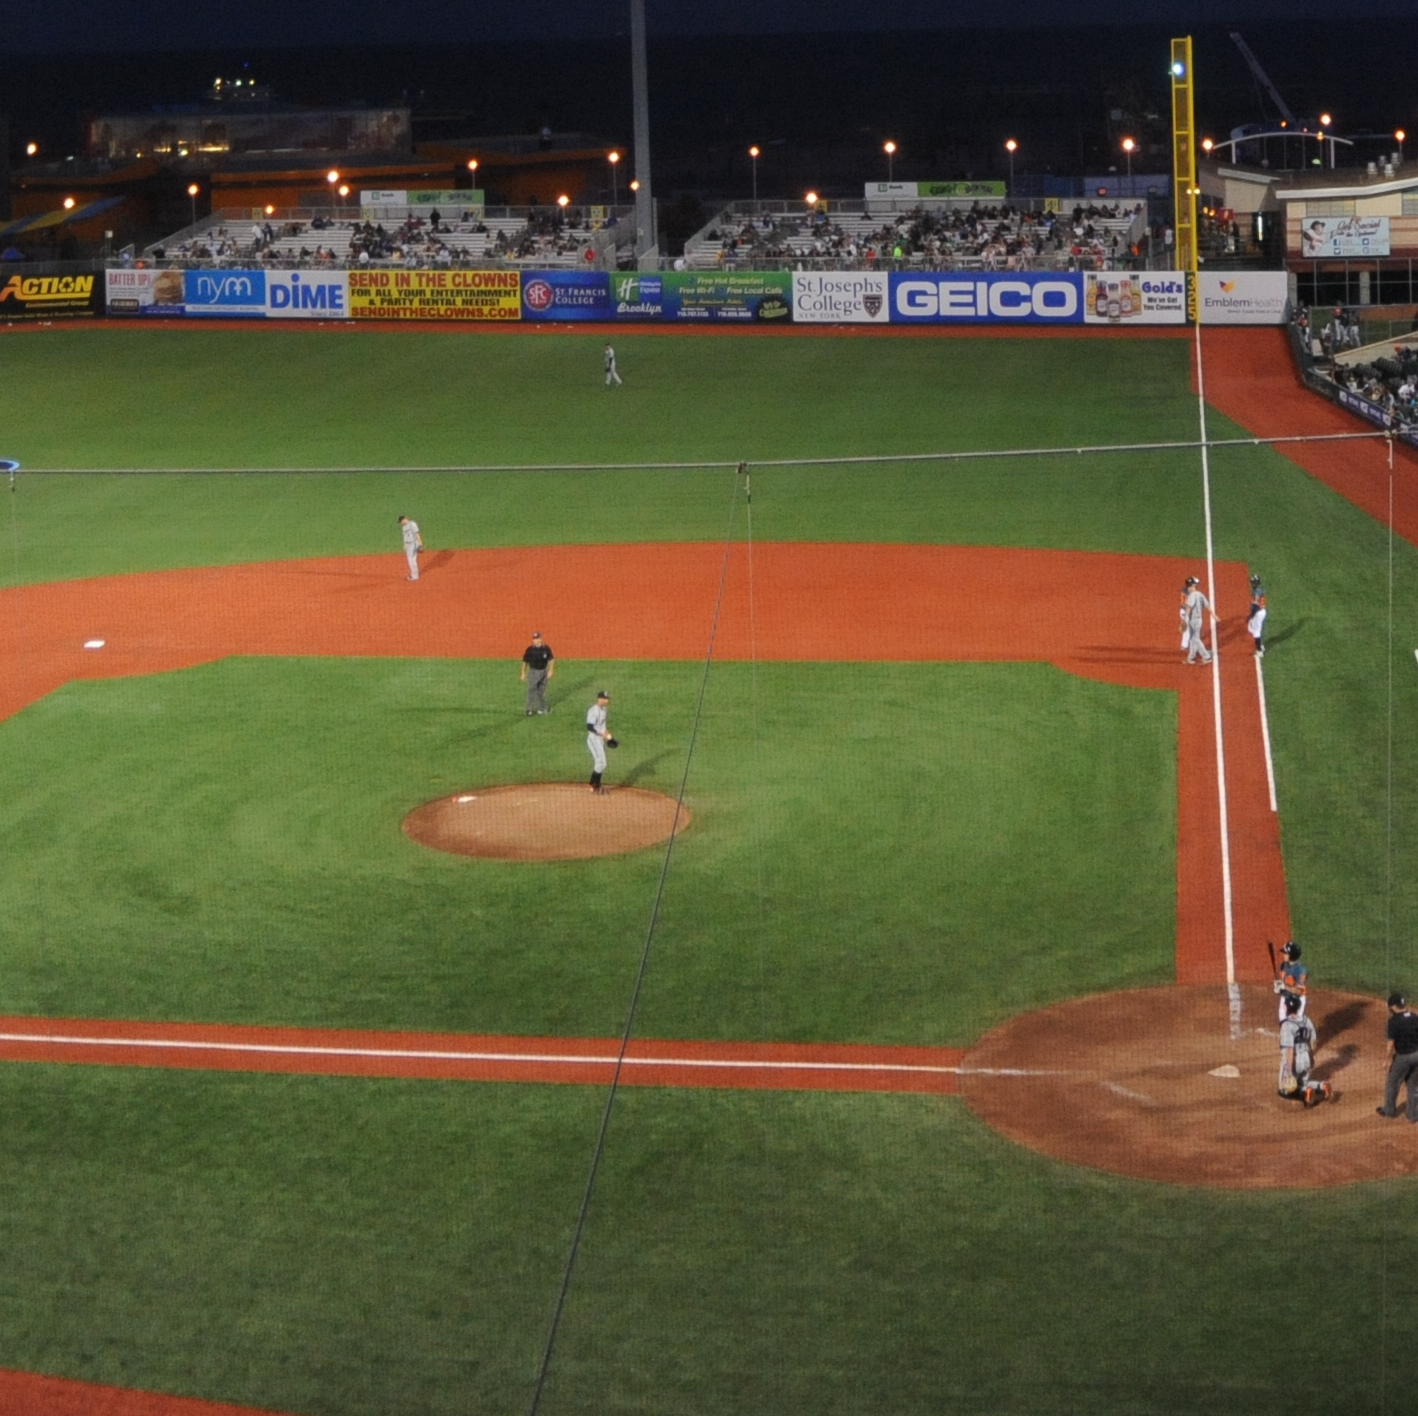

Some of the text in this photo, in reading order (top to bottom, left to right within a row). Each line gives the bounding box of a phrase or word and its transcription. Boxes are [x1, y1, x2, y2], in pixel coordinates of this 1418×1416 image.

[349, 272, 519, 288] SEND IN THE CLOWNS
[697, 277, 713, 285] Free
[351, 289, 518, 298] FOR ALL YOUR ENTERTAINMENT
[797, 277, 883, 298] St. Joseph's
[1141, 281, 1183, 294] Gold's
[368, 298, 500, 307] & PARTY RENTAL NEEDS!
[555, 297, 594, 305] COLLEGE
[798, 294, 862, 316] College
[896, 281, 1078, 317] GEICO
[1204, 297, 1283, 307] EmblemHealth
[351, 306, 519, 318] SENDINTHECLOWNS.COM
[617, 302, 662, 315] Brooklyn
[1143, 304, 1155, 312] You
